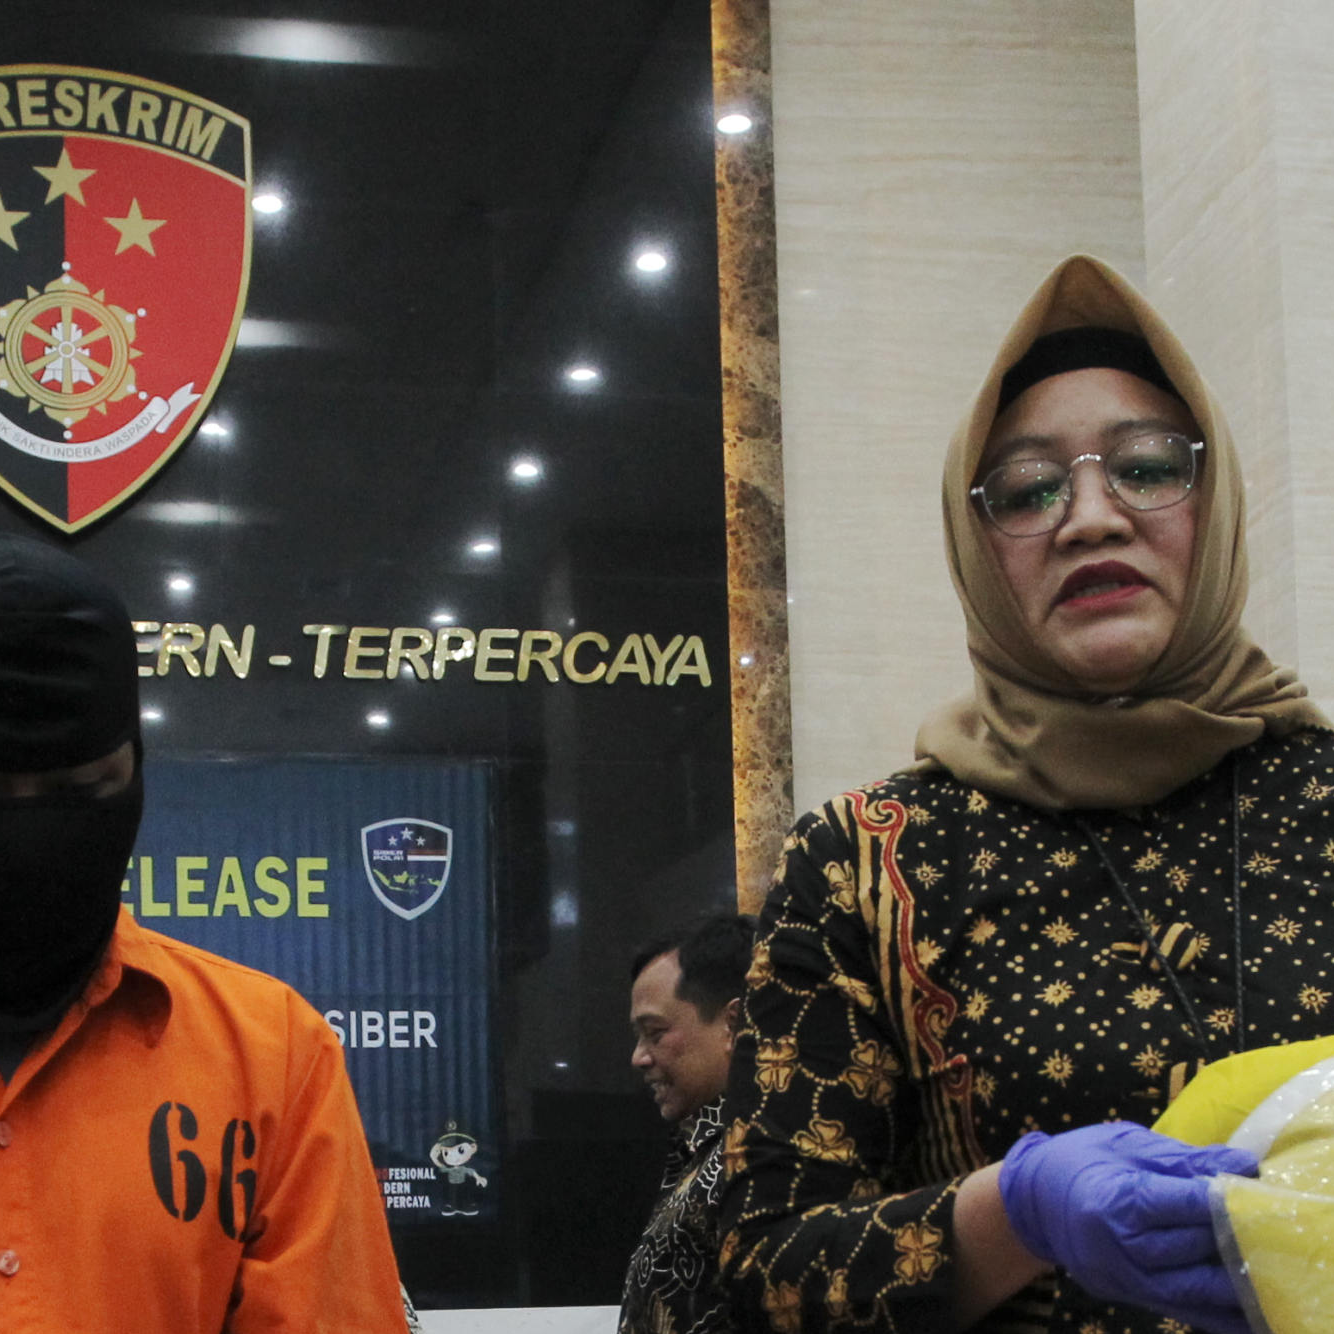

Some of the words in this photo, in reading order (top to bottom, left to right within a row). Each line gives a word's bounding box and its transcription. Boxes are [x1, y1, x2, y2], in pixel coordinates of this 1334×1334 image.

[53, 445, 102, 459] INDERA
[105, 411, 158, 451] WASPADA
[303, 624, 713, 687] TERPERCAYA
[324, 1009, 439, 1049] SIBER
[148, 1100, 269, 1250] 66
